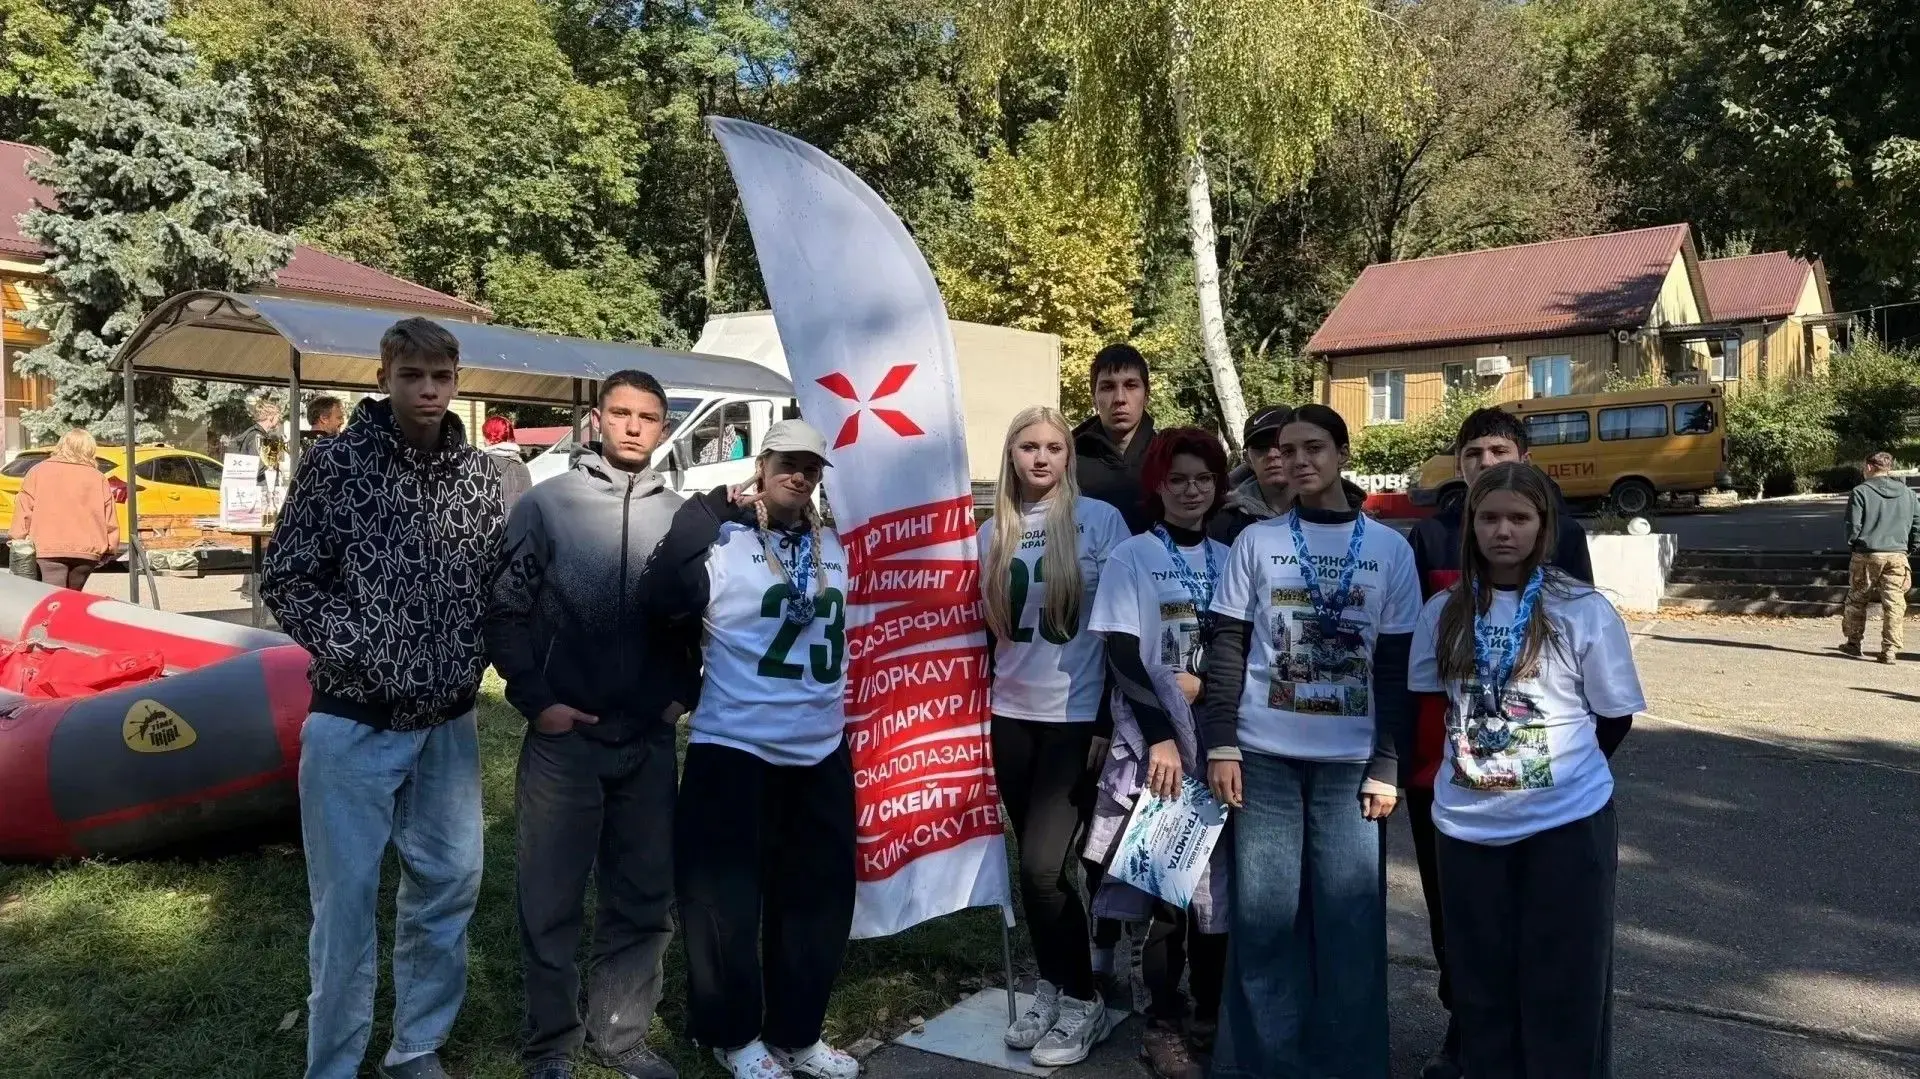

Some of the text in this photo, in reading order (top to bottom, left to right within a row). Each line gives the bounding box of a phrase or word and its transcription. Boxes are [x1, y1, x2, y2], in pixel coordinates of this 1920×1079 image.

[1547, 461, 1594, 478] ДЕТИ
[757, 583, 844, 685] 23
[882, 694, 964, 739] ПАРКУР
[878, 783, 962, 822] СКЕЙТ
[1167, 811, 1200, 869] ГРАМОТА
